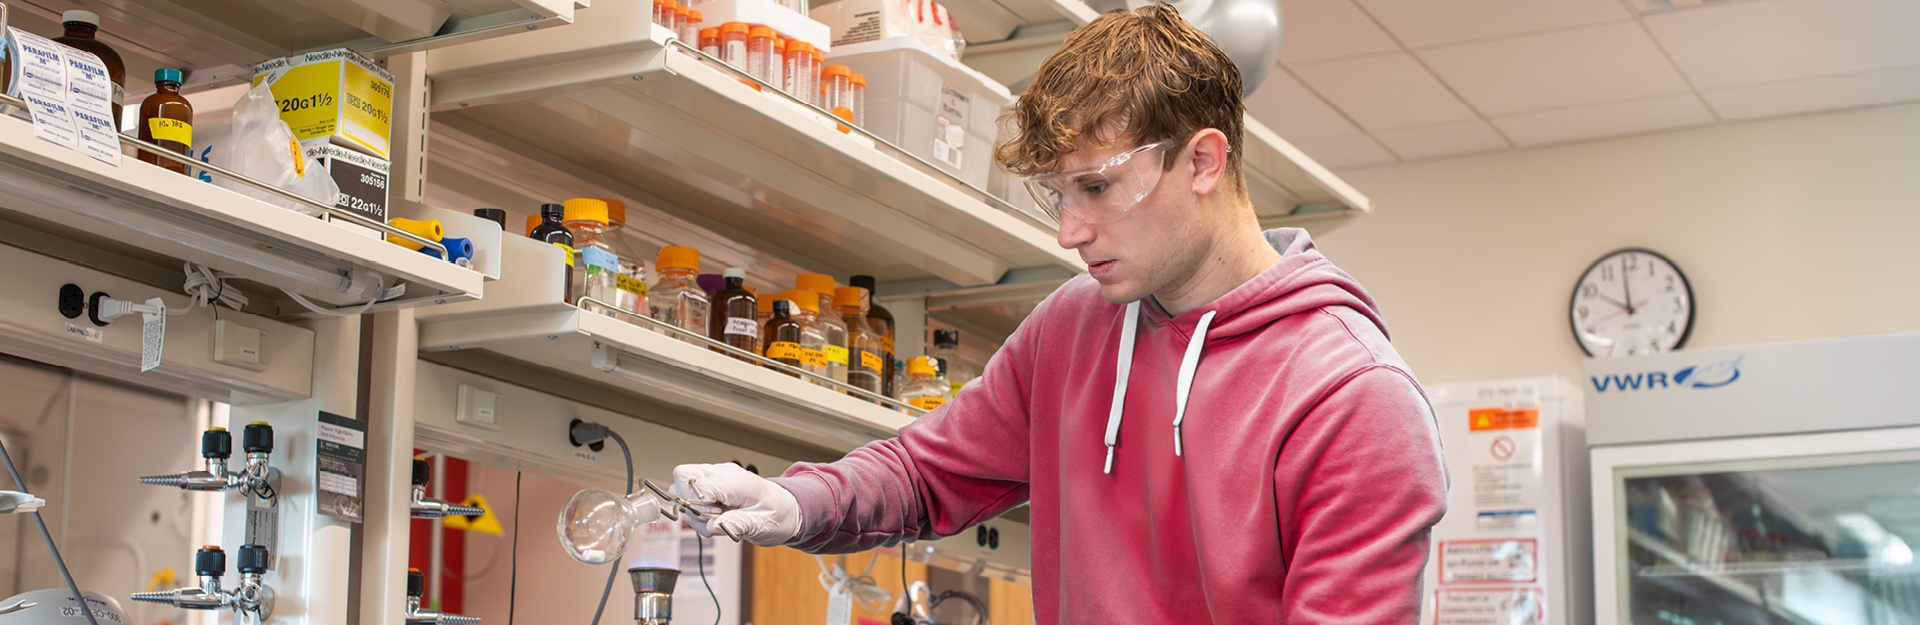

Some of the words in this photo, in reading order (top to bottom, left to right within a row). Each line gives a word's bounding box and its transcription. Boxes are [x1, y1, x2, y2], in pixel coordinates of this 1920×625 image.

[22, 45, 60, 62] PARAFILM
[27, 61, 50, 72] LABORATORY
[69, 59, 105, 77] PARAFILM
[74, 76, 96, 86] LABORATORY
[28, 96, 66, 112] PARAFILM
[74, 110, 112, 128] PARAFILM
[360, 174, 385, 190] 305156
[1602, 264, 1614, 282] 11
[1648, 260, 1654, 277] 1
[1582, 281, 1598, 300] 10
[1664, 274, 1676, 293] 2
[1578, 304, 1589, 323] 9
[1672, 297, 1683, 314] 3
[1591, 372, 1668, 392] VWR
[62, 606, 121, 622] 300-CET-02
